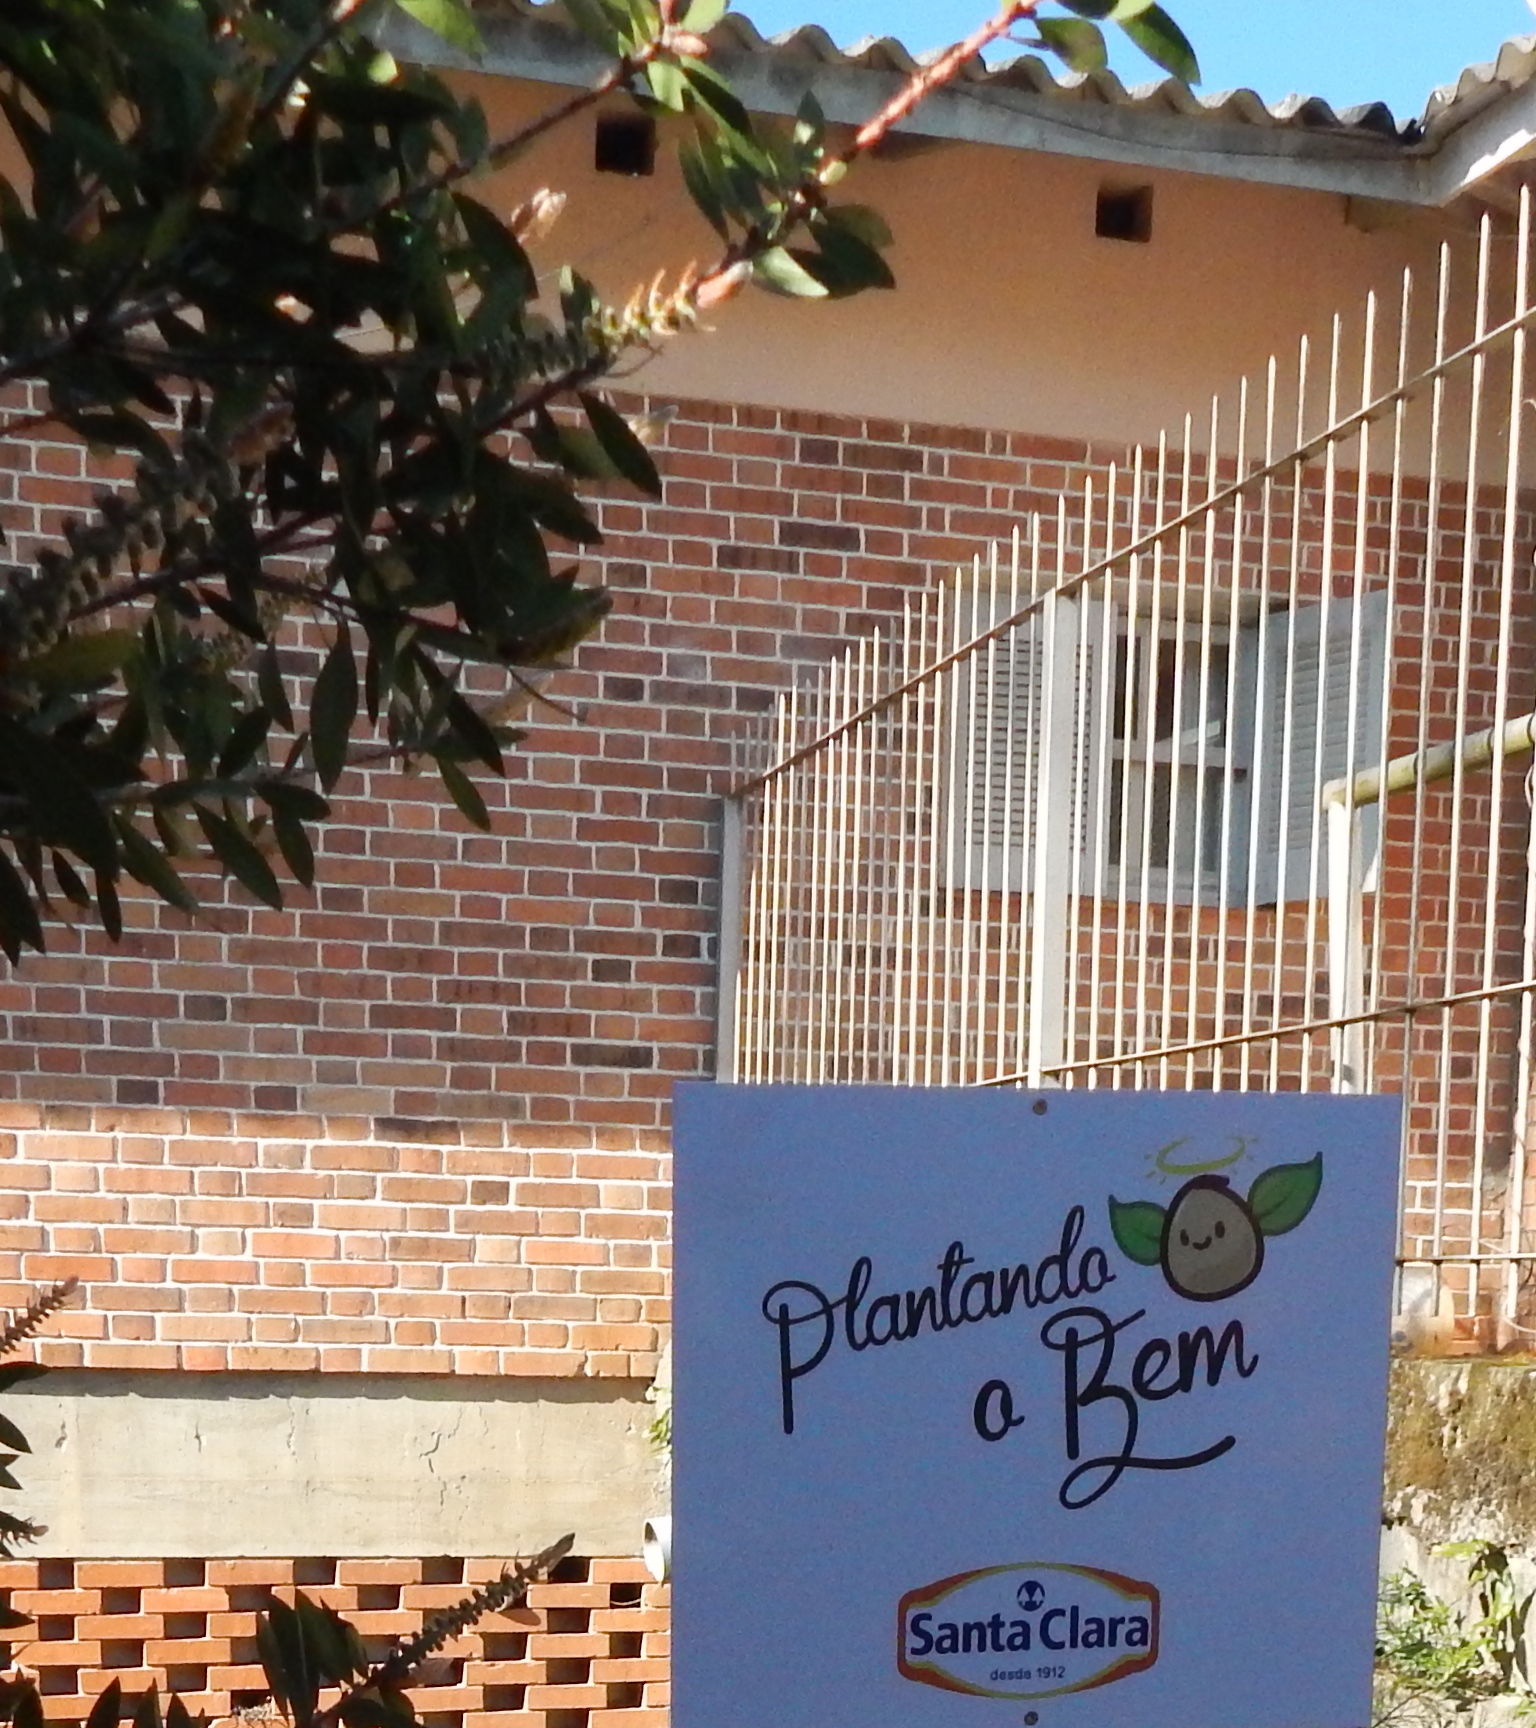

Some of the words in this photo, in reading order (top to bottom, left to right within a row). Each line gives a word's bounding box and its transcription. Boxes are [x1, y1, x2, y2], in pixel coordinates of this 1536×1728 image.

[763, 1204, 1117, 1434] Plantando
[973, 1379, 1025, 1442] o
[1040, 1305, 1259, 1510] Bem
[910, 1612, 1031, 1656] Santa
[1039, 1605, 1150, 1651] Clara
[990, 1668, 1032, 1682] desde
[1036, 1665, 1066, 1680] 1912
